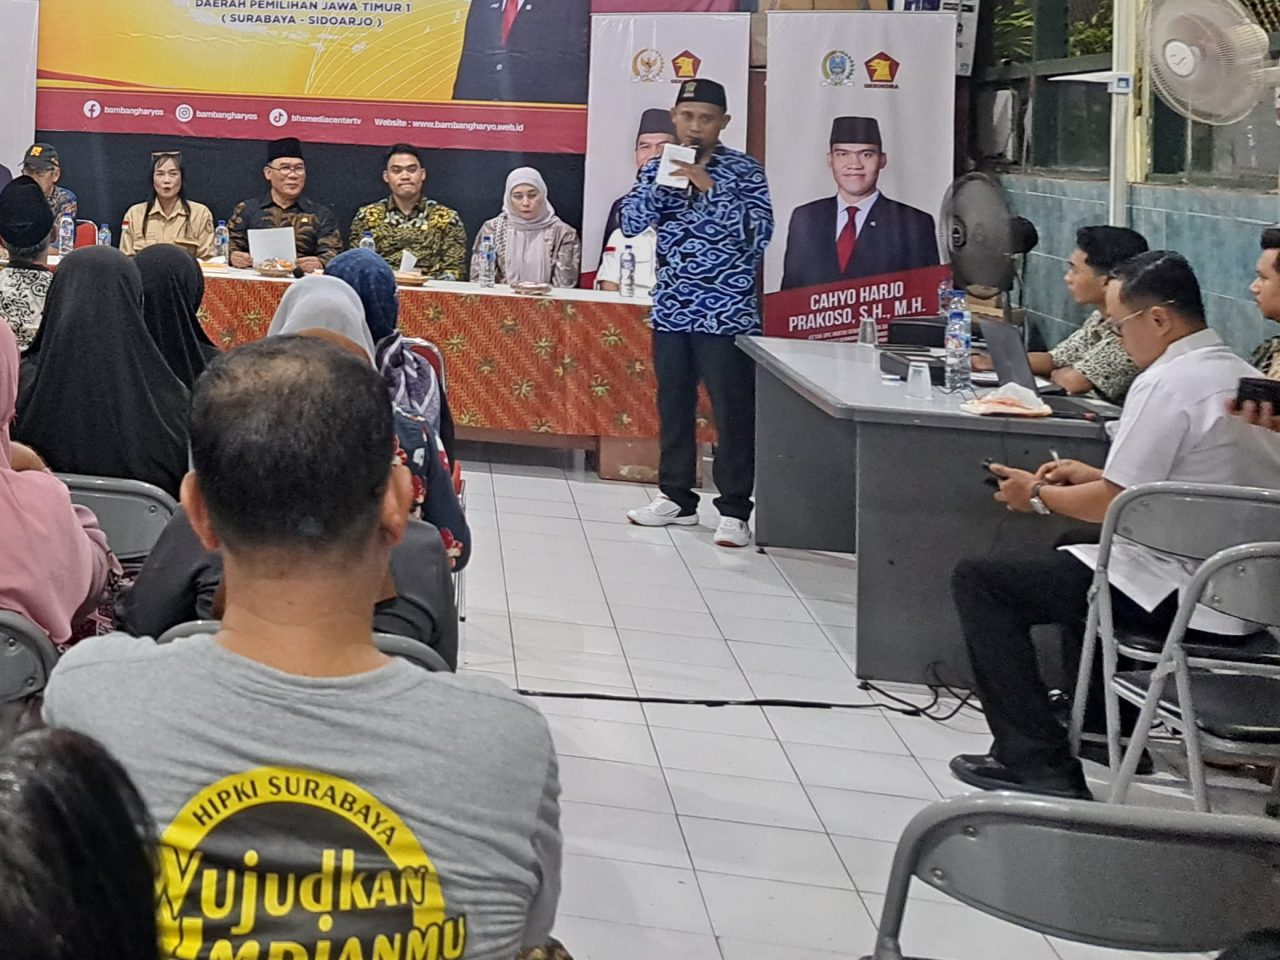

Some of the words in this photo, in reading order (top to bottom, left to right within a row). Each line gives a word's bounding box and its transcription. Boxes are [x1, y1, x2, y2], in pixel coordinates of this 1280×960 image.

[250, 0, 318, 10] PEMILIHAN
[321, 1, 358, 12] JAWA
[362, 2, 402, 12] TIMUR
[405, 3, 411, 13] 1
[229, 14, 296, 24] SURABAYA
[308, 16, 373, 26] SIDOARJO
[104, 106, 164, 117] bambangharyos
[196, 109, 258, 121] bambangharyos
[291, 113, 362, 125] bhsmediacentertv
[374, 118, 407, 127] Website
[412, 120, 524, 132] www.bambangharyo.web.id
[810, 289, 857, 310] CAHYO
[859, 281, 904, 302] HARJO
[788, 308, 856, 332] PRAKOSO,
[859, 303, 891, 321] S.H.,
[894, 296, 926, 316] M.H.
[192, 780, 259, 827] HIPKI
[268, 775, 397, 846] SURABAYA
